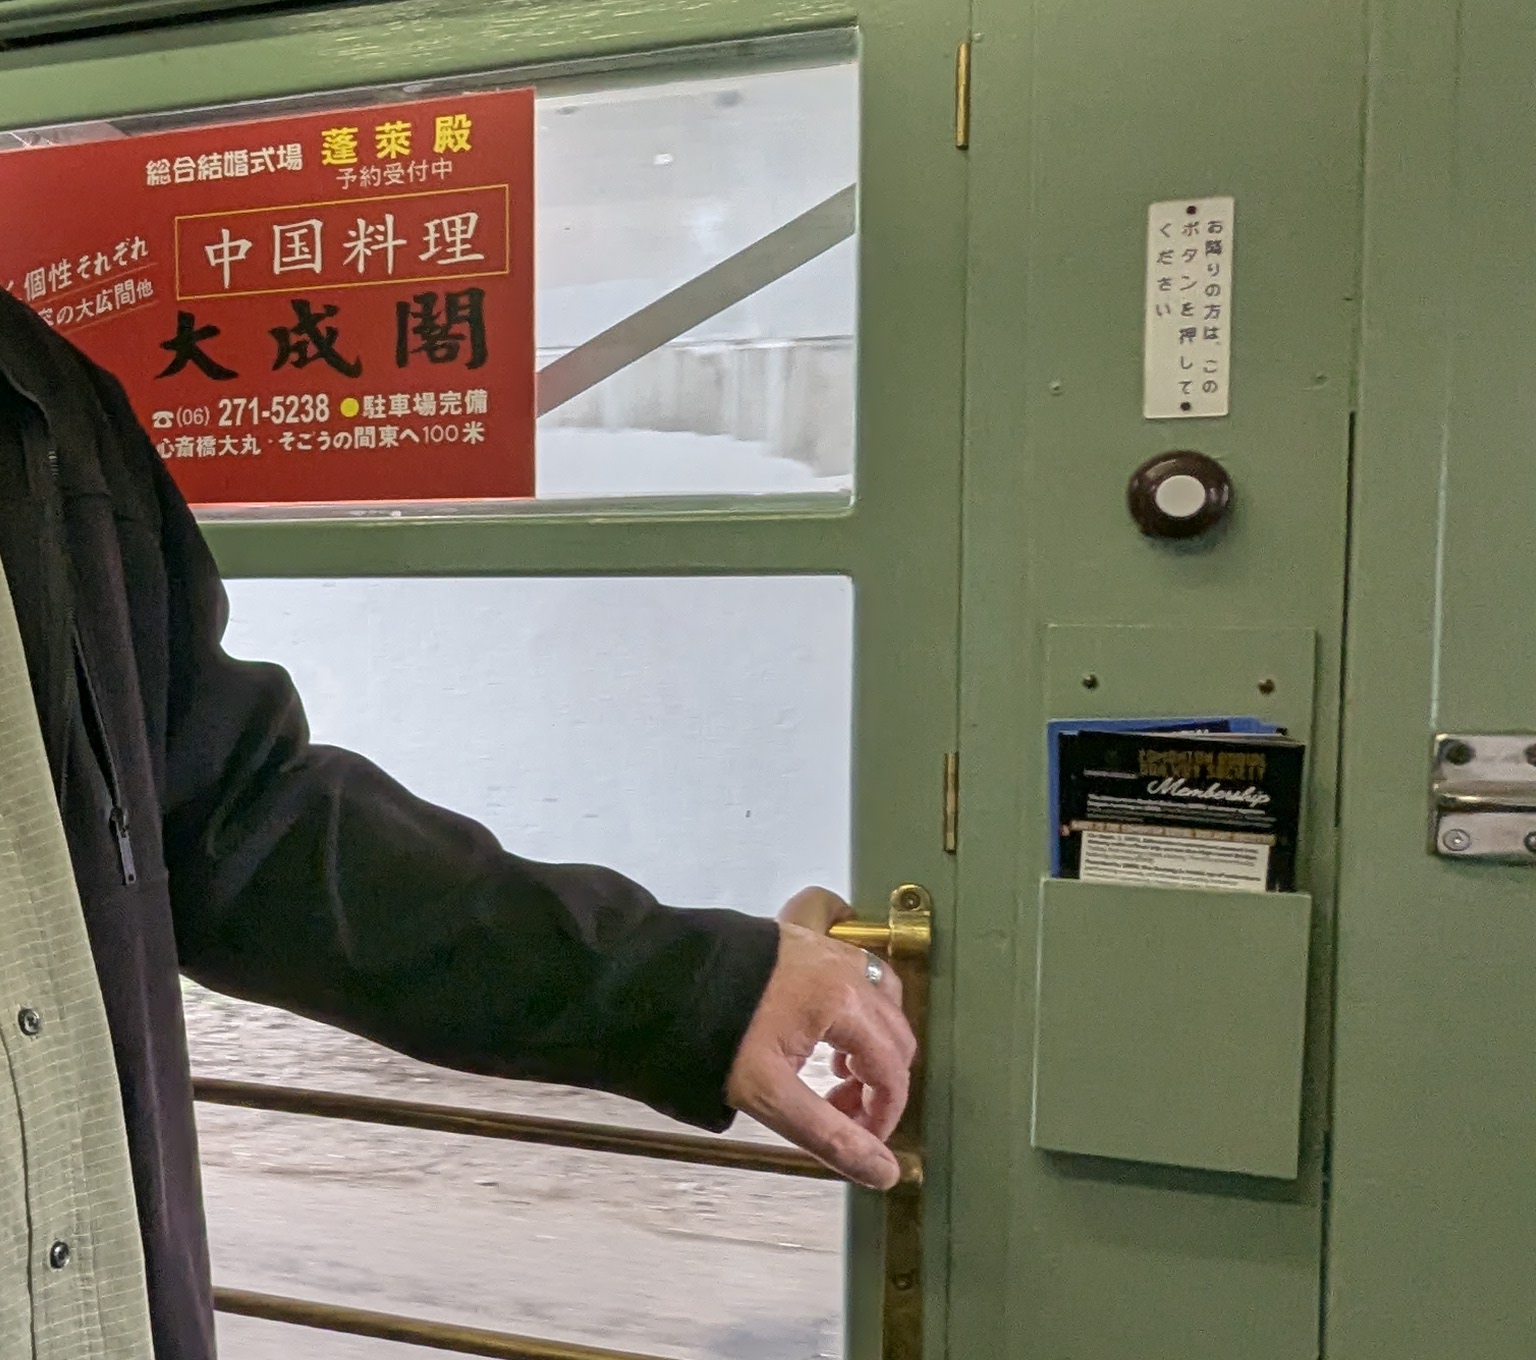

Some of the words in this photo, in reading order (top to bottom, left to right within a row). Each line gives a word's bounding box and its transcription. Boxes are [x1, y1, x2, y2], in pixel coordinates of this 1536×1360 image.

[145, 142, 304, 187] 総合結婚式場
[335, 157, 454, 191] 予約受付中
[204, 211, 486, 290] 中国料理
[1156, 223, 1175, 318] ください
[154, 287, 490, 381] 大成閣
[1178, 221, 1200, 395] ボタンを押して
[175, 405, 212, 428] (06)
[218, 392, 331, 428] 271-5238
[363, 389, 490, 420] 駐車場完備
[1146, 776, 1271, 808] Membership
